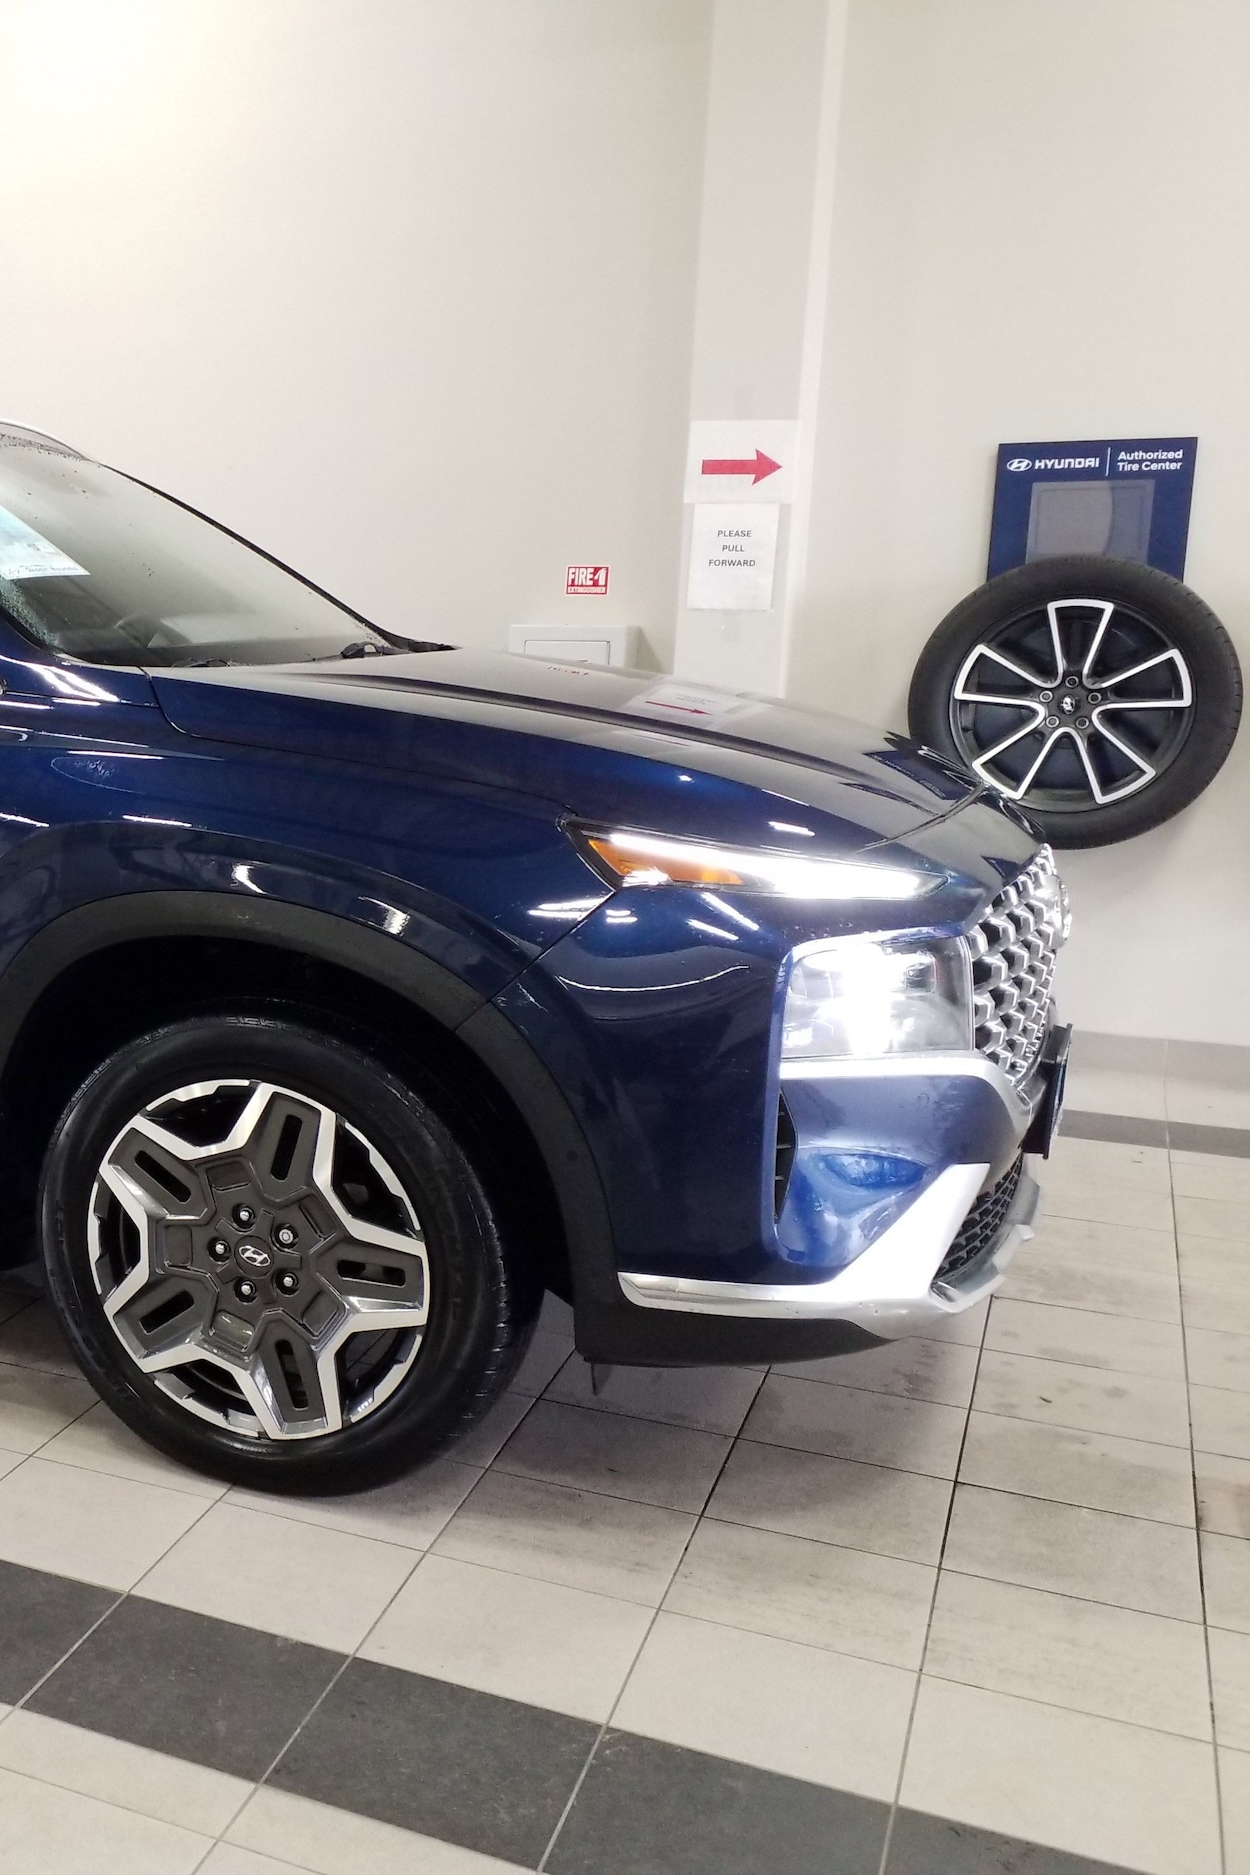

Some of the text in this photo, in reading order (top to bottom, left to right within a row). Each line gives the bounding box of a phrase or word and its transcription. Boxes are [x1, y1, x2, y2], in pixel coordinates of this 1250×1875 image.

[1117, 448, 1184, 461] Authorized
[1034, 457, 1100, 470] HYUNDAI
[1116, 461, 1183, 472] Tire Center
[717, 529, 752, 538] PLEASE
[722, 544, 745, 552] PULL
[708, 559, 756, 567] FORWARD
[567, 567, 594, 586] FIRE
